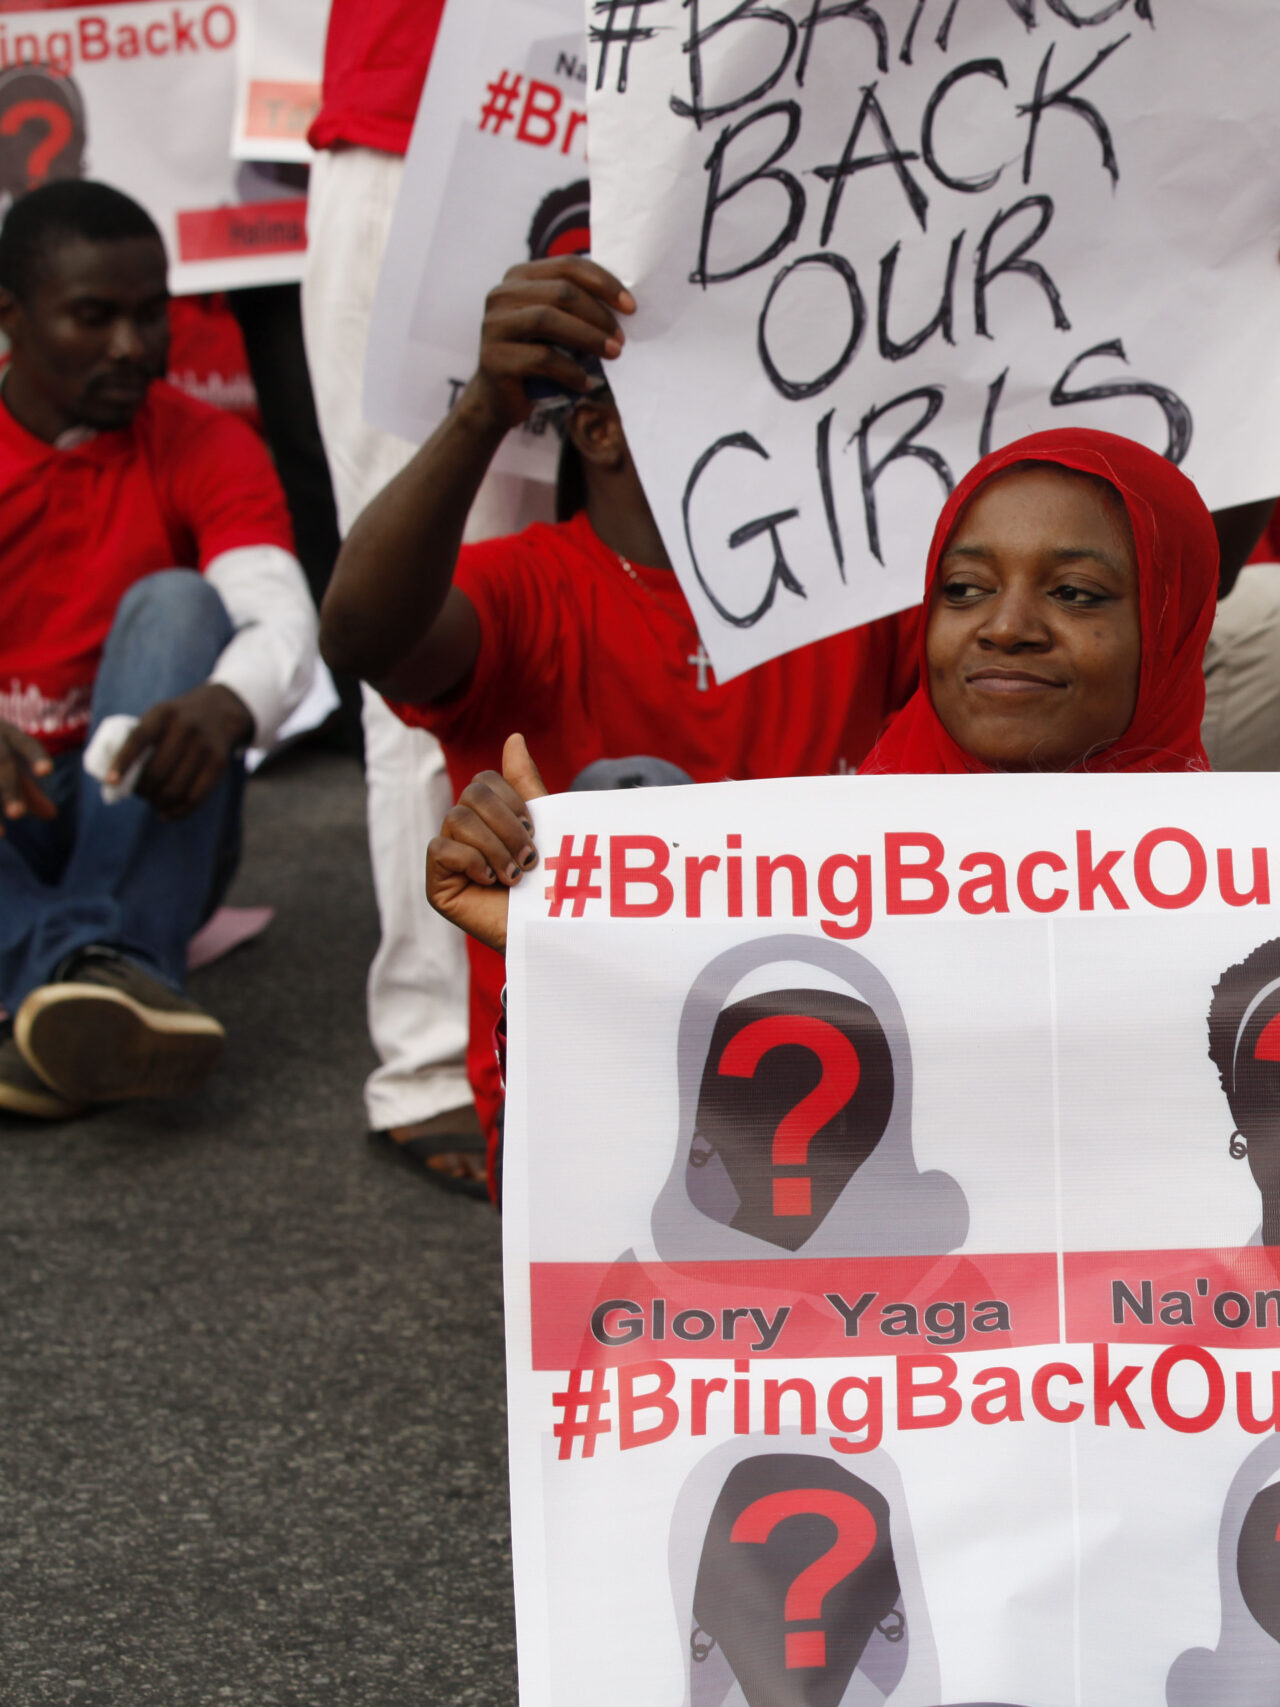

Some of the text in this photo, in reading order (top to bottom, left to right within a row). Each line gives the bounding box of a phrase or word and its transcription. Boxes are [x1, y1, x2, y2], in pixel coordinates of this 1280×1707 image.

[689, 33, 1131, 290] BACK
[758, 194, 1071, 400] OUR
[590, 1292, 1012, 1351] Glory Yaga
